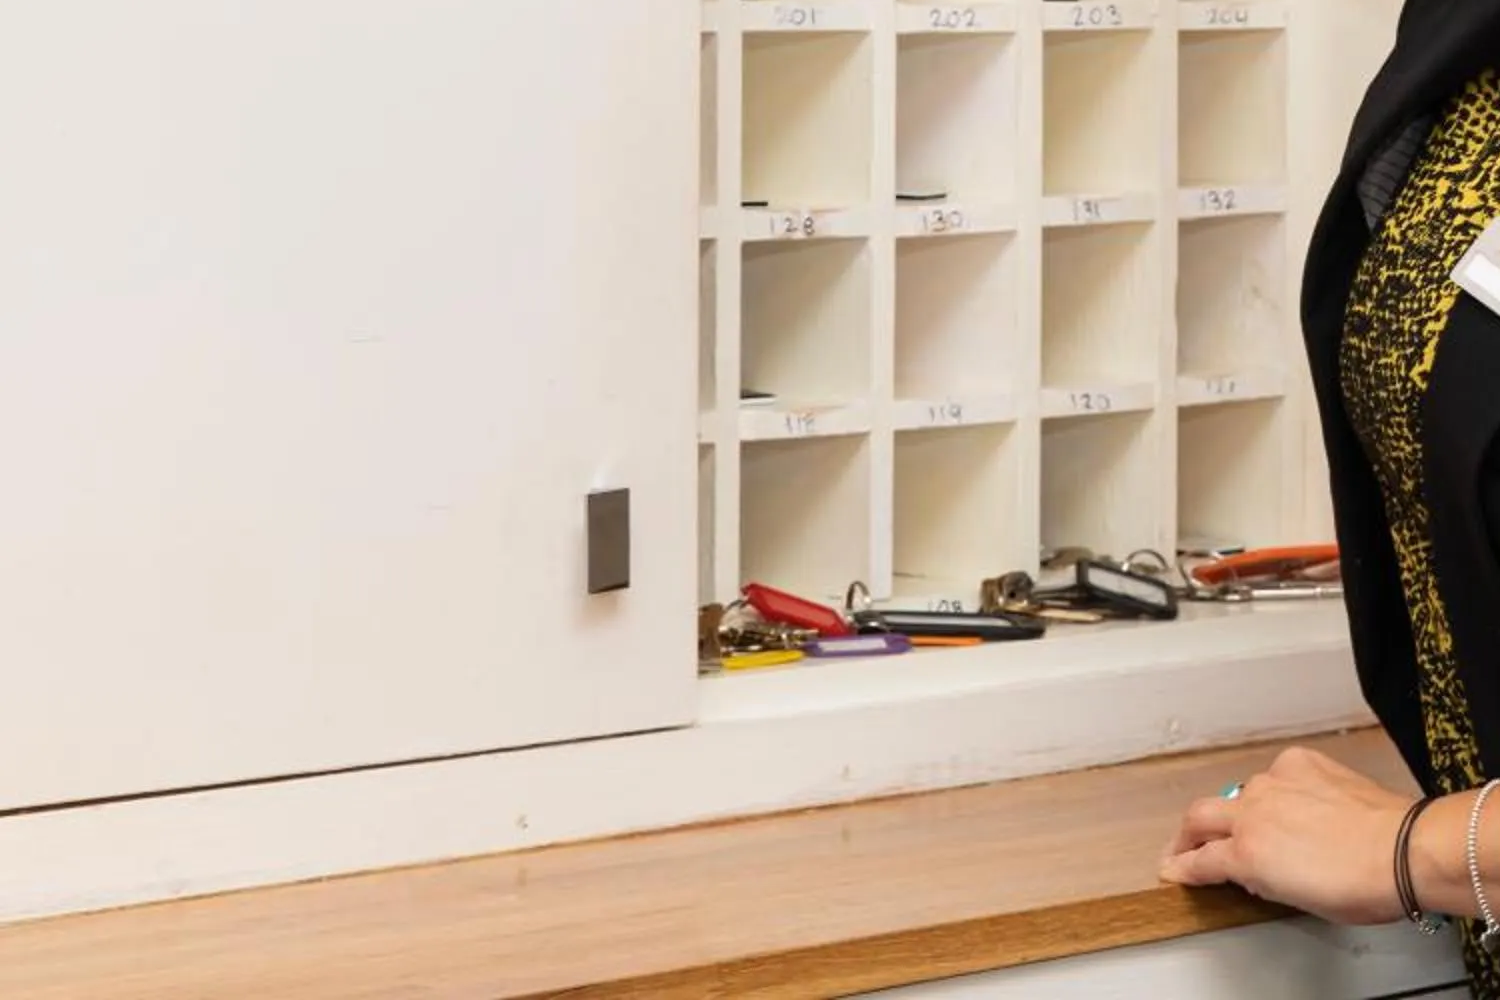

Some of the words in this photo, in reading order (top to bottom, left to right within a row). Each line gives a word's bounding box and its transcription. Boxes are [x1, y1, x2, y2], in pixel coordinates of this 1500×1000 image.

[928, 6, 978, 28] 202
[1073, 3, 1122, 27] 203
[1199, 190, 1235, 210] 132
[769, 215, 815, 237] 128
